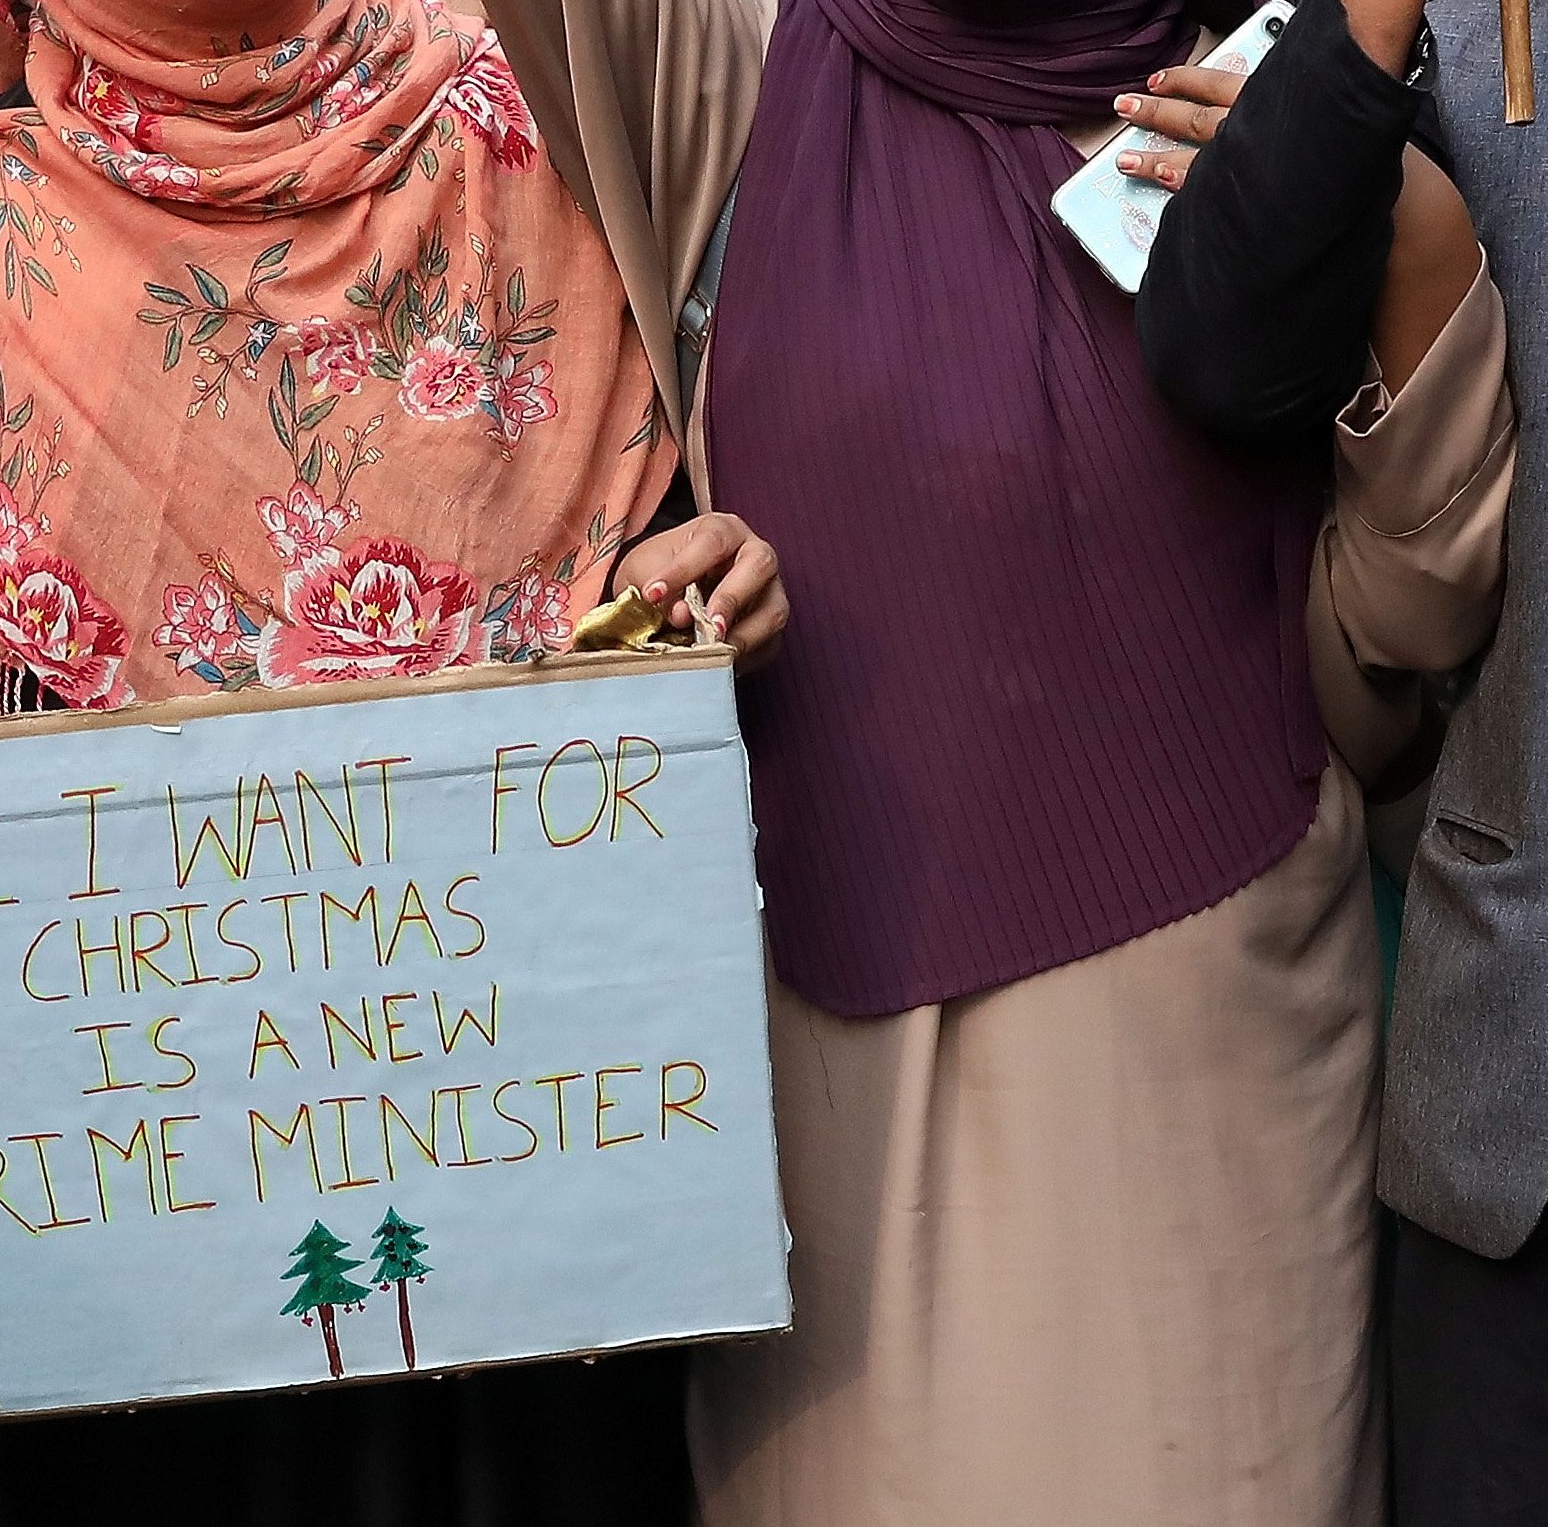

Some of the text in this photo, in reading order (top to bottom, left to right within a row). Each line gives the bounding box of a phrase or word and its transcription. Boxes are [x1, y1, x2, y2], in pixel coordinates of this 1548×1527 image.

[61, 787, 120, 899] I
[168, 757, 411, 888] WANT
[491, 736, 662, 854] FOR
[22, 875, 486, 1000] CHRISTMAS
[76, 983, 498, 1095] IS A NEW
[249, 1060, 717, 1200] MINISTER
